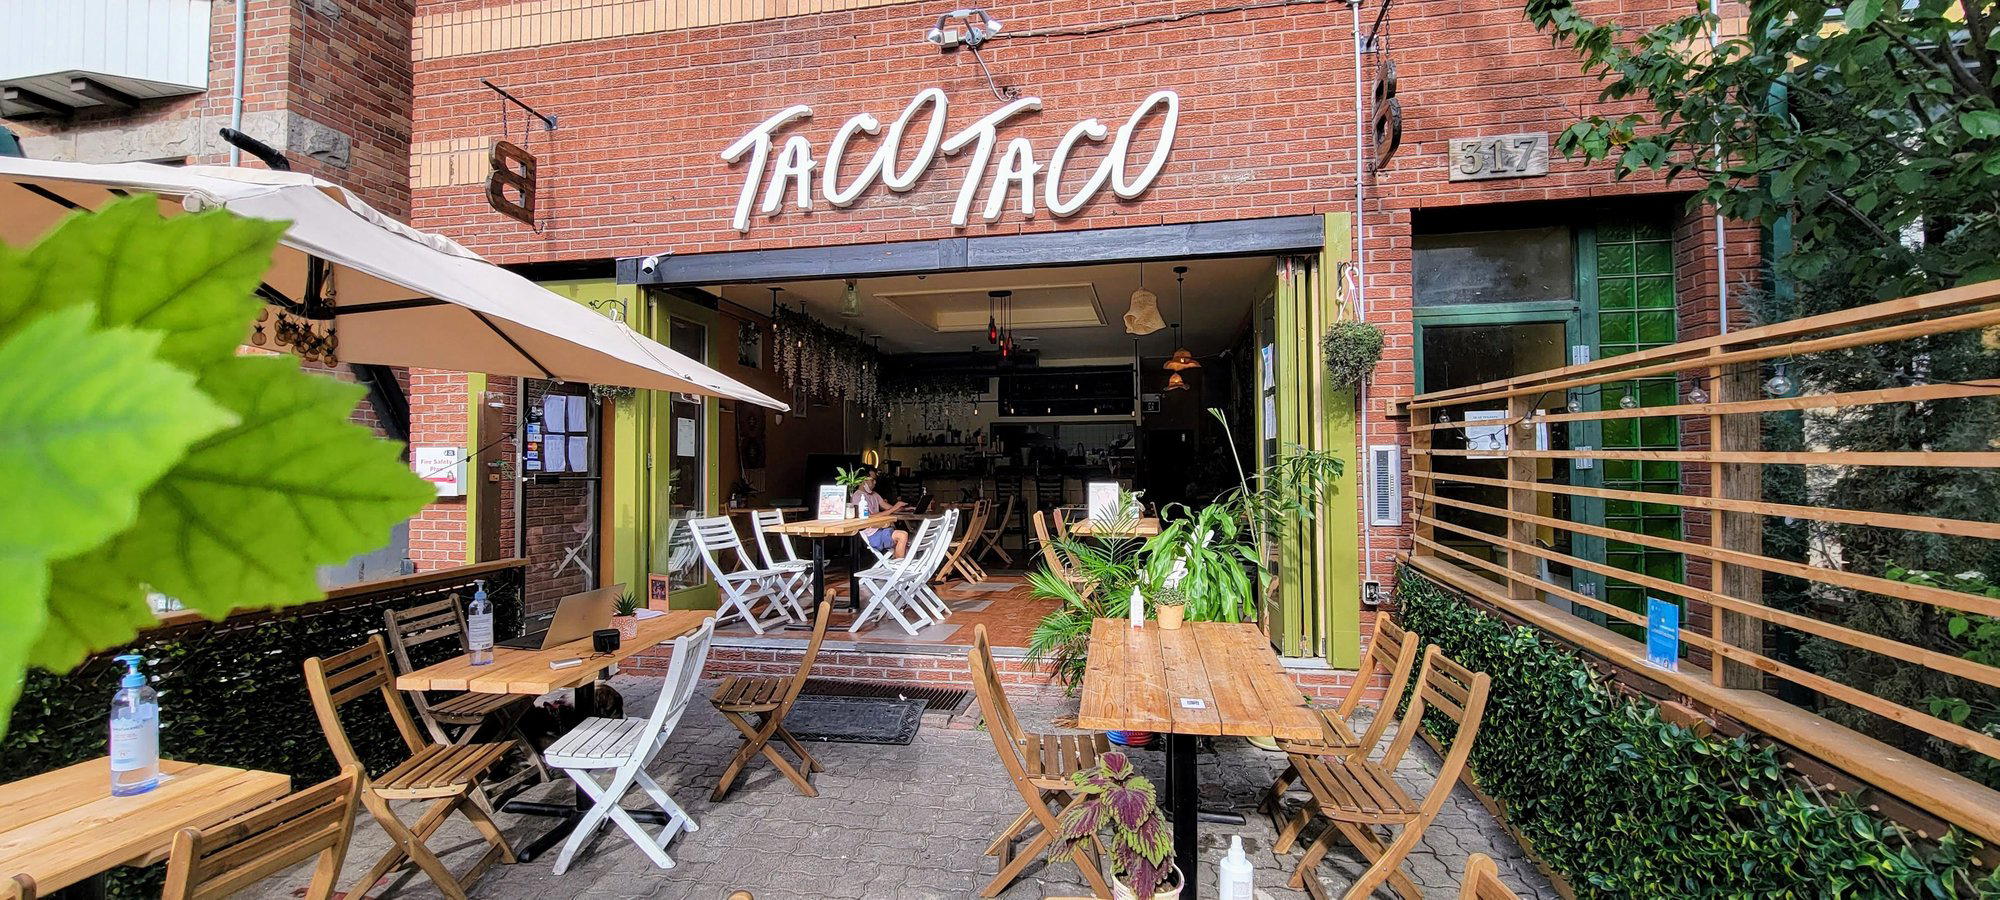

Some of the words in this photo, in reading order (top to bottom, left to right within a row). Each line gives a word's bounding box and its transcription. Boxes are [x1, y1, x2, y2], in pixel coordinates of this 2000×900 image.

[720, 88, 948, 234] TACO
[940, 90, 1180, 229] TACO
[1460, 137, 1539, 174] 317
